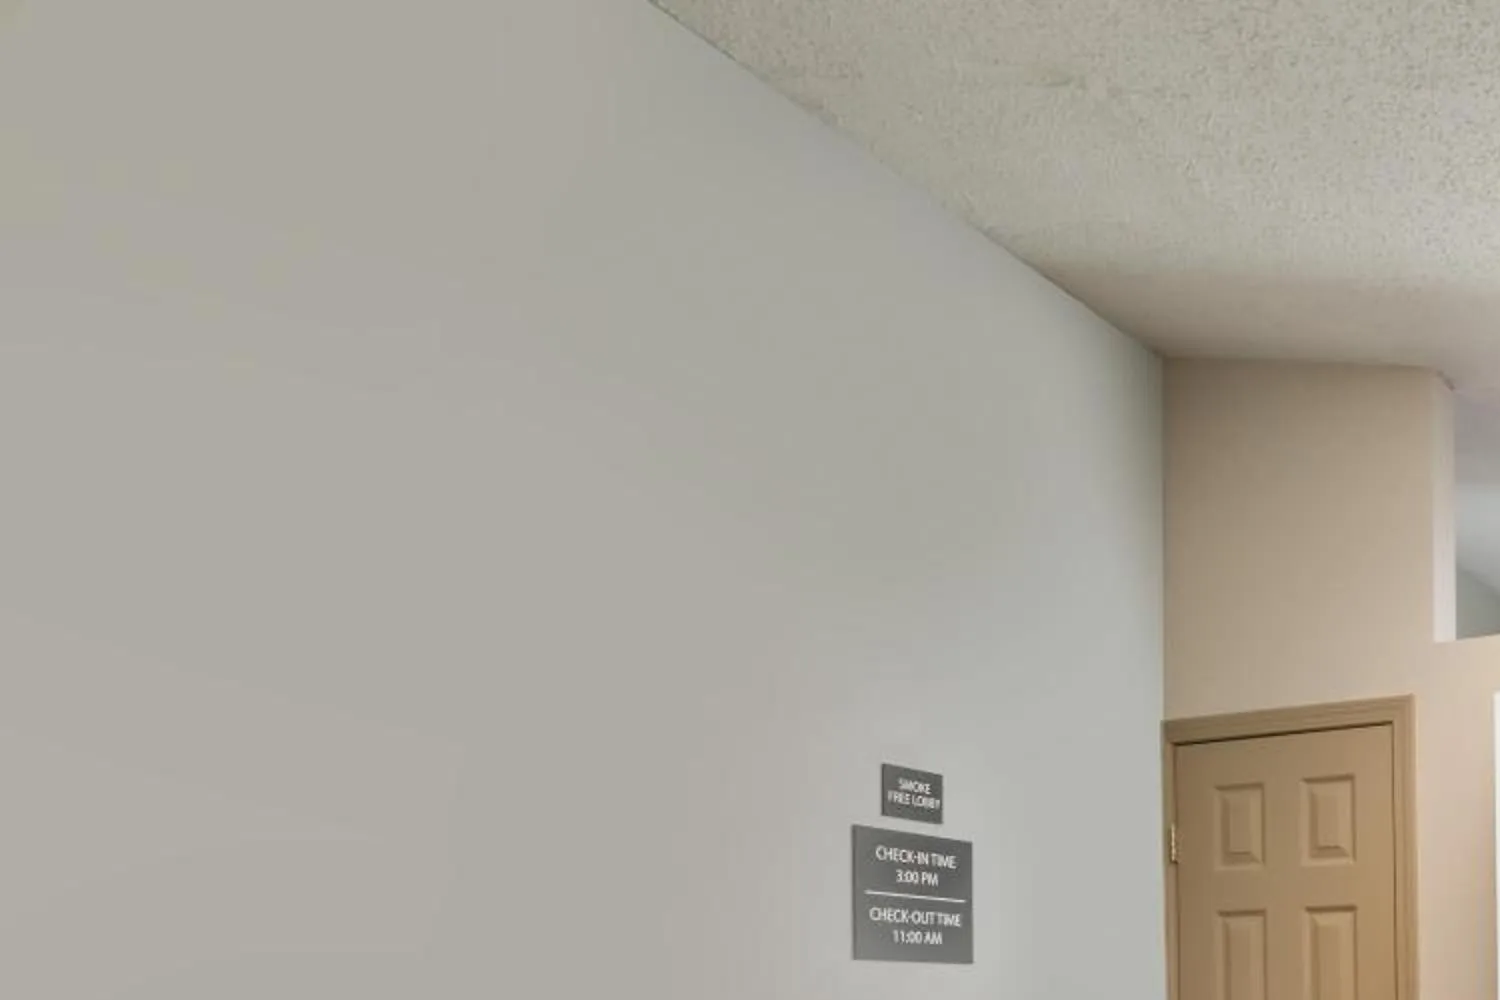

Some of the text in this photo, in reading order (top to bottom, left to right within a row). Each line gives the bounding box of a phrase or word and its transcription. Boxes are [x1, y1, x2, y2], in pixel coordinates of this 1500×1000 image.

[898, 777, 931, 795] SMOKE
[887, 790, 941, 810] FREE LOBBY
[875, 845, 957, 869] CHECK-IN TIME
[896, 869, 939, 887] 3:00 PM
[869, 907, 961, 928] CHECK-OUT TIME
[893, 930, 943, 945] 11:00 AM
